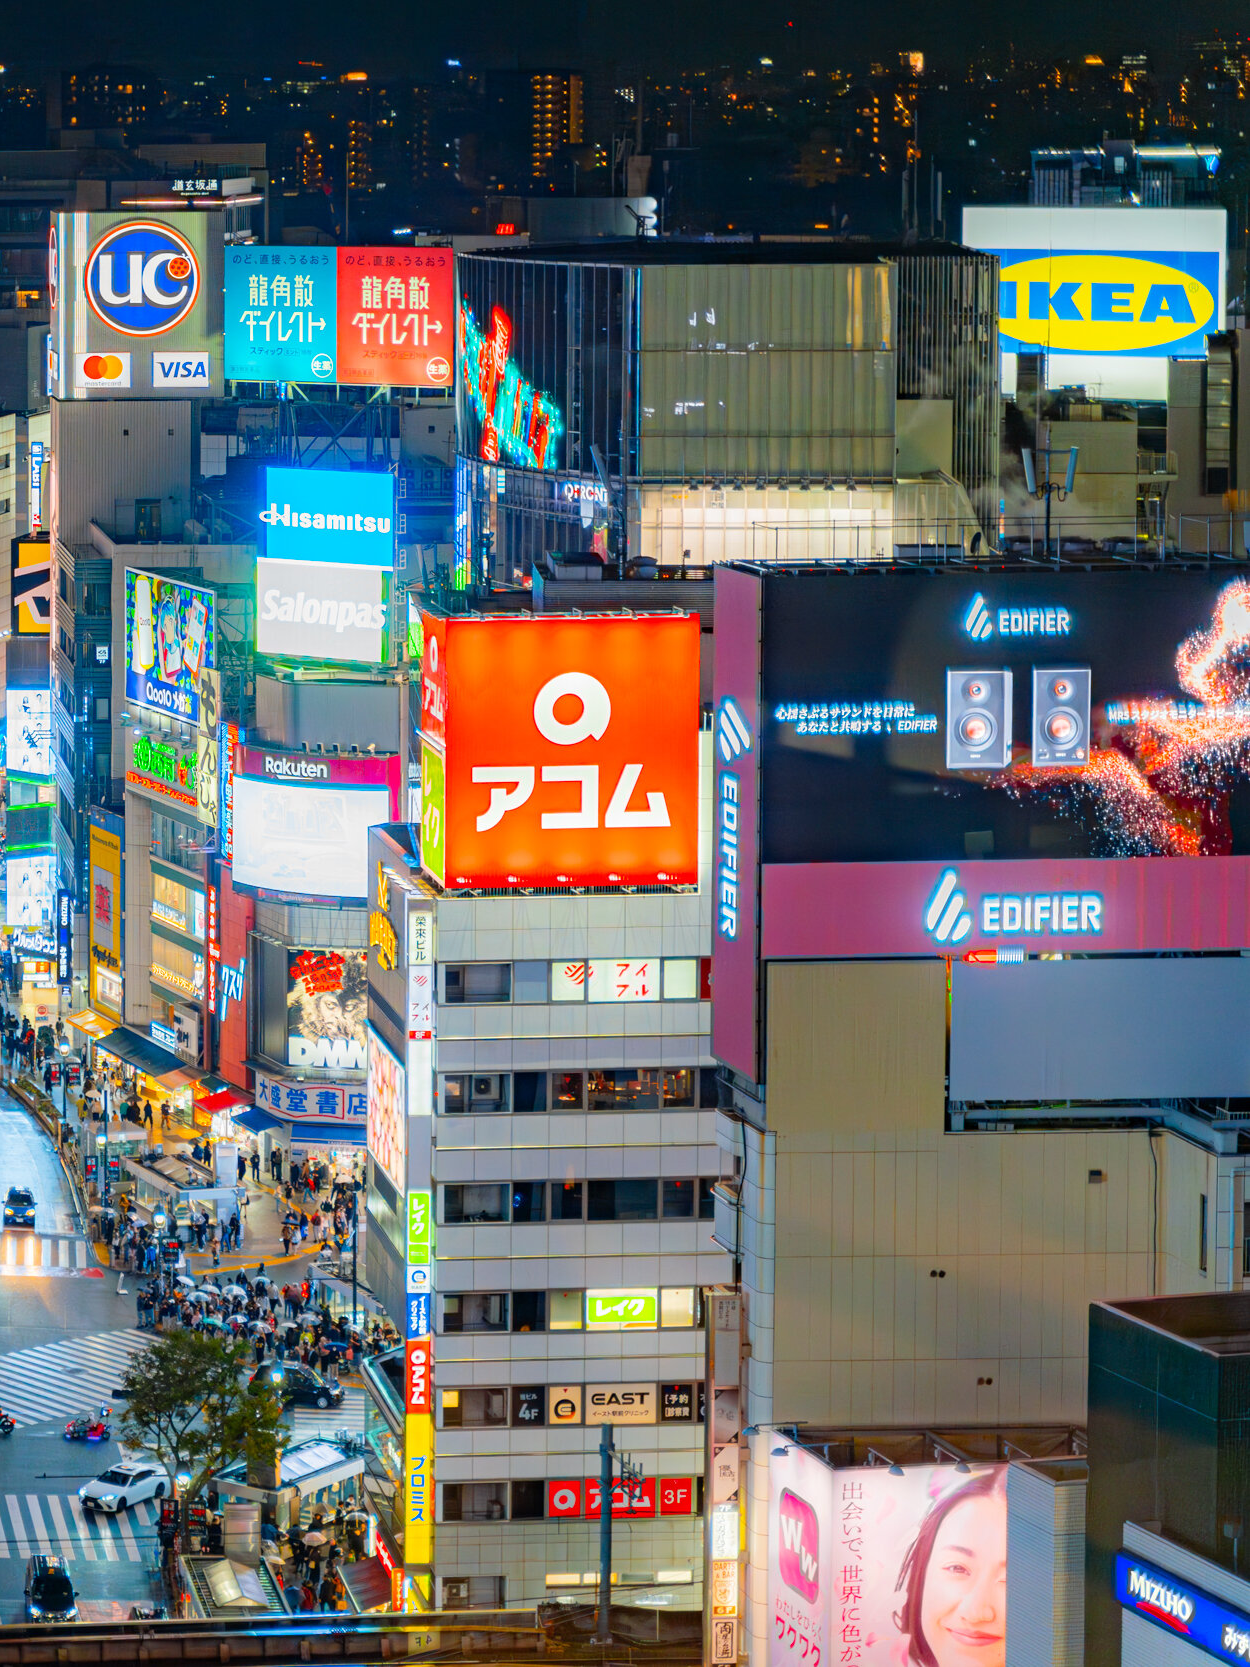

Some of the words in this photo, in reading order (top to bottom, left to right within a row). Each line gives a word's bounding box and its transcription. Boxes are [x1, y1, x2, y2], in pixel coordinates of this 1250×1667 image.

[232, 254, 330, 266] のど、直接、うるおう
[345, 255, 447, 268] のど、直接、うるおう
[248, 274, 314, 308] 龍角散
[361, 276, 431, 310] 龍角散
[999, 280, 1197, 324] IKEA
[155, 361, 207, 379] VISA
[32, 456, 41, 487] LABI
[564, 482, 608, 502] QFRONT
[258, 503, 391, 534] Hisamitsu
[261, 588, 387, 633] Salonpas
[999, 607, 1070, 635] EDIFIER
[146, 681, 172, 708] Qoo10
[423, 677, 444, 723] アコム
[897, 719, 938, 732] EDIFIER
[264, 756, 328, 780] Rakuten
[471, 763, 672, 833] アコム
[719, 774, 740, 939] EDIFIER
[982, 895, 1103, 934] EDIFIER
[414, 1031, 426, 1039] 8F
[259, 1080, 368, 1117] 大盛堂書店
[411, 1197, 426, 1236] レイク
[595, 1298, 645, 1317] レイク
[411, 1365, 426, 1406] アコム
[591, 1392, 650, 1406] EAST
[518, 1403, 539, 1420] 4F
[592, 1409, 650, 1417] イースト駅前クリニック
[410, 1455, 426, 1522] プロミス
[664, 1489, 688, 1504] 3F
[713, 1562, 736, 1571] DARTS
[722, 1571, 736, 1579] BAR
[839, 1481, 864, 1667] 出会いで、世界に色が
[716, 1606, 733, 1614] 6F
[1130, 1569, 1193, 1623] MIZUHO
[775, 1614, 821, 1667] ワクワク
[1222, 1626, 1250, 1660] みず
